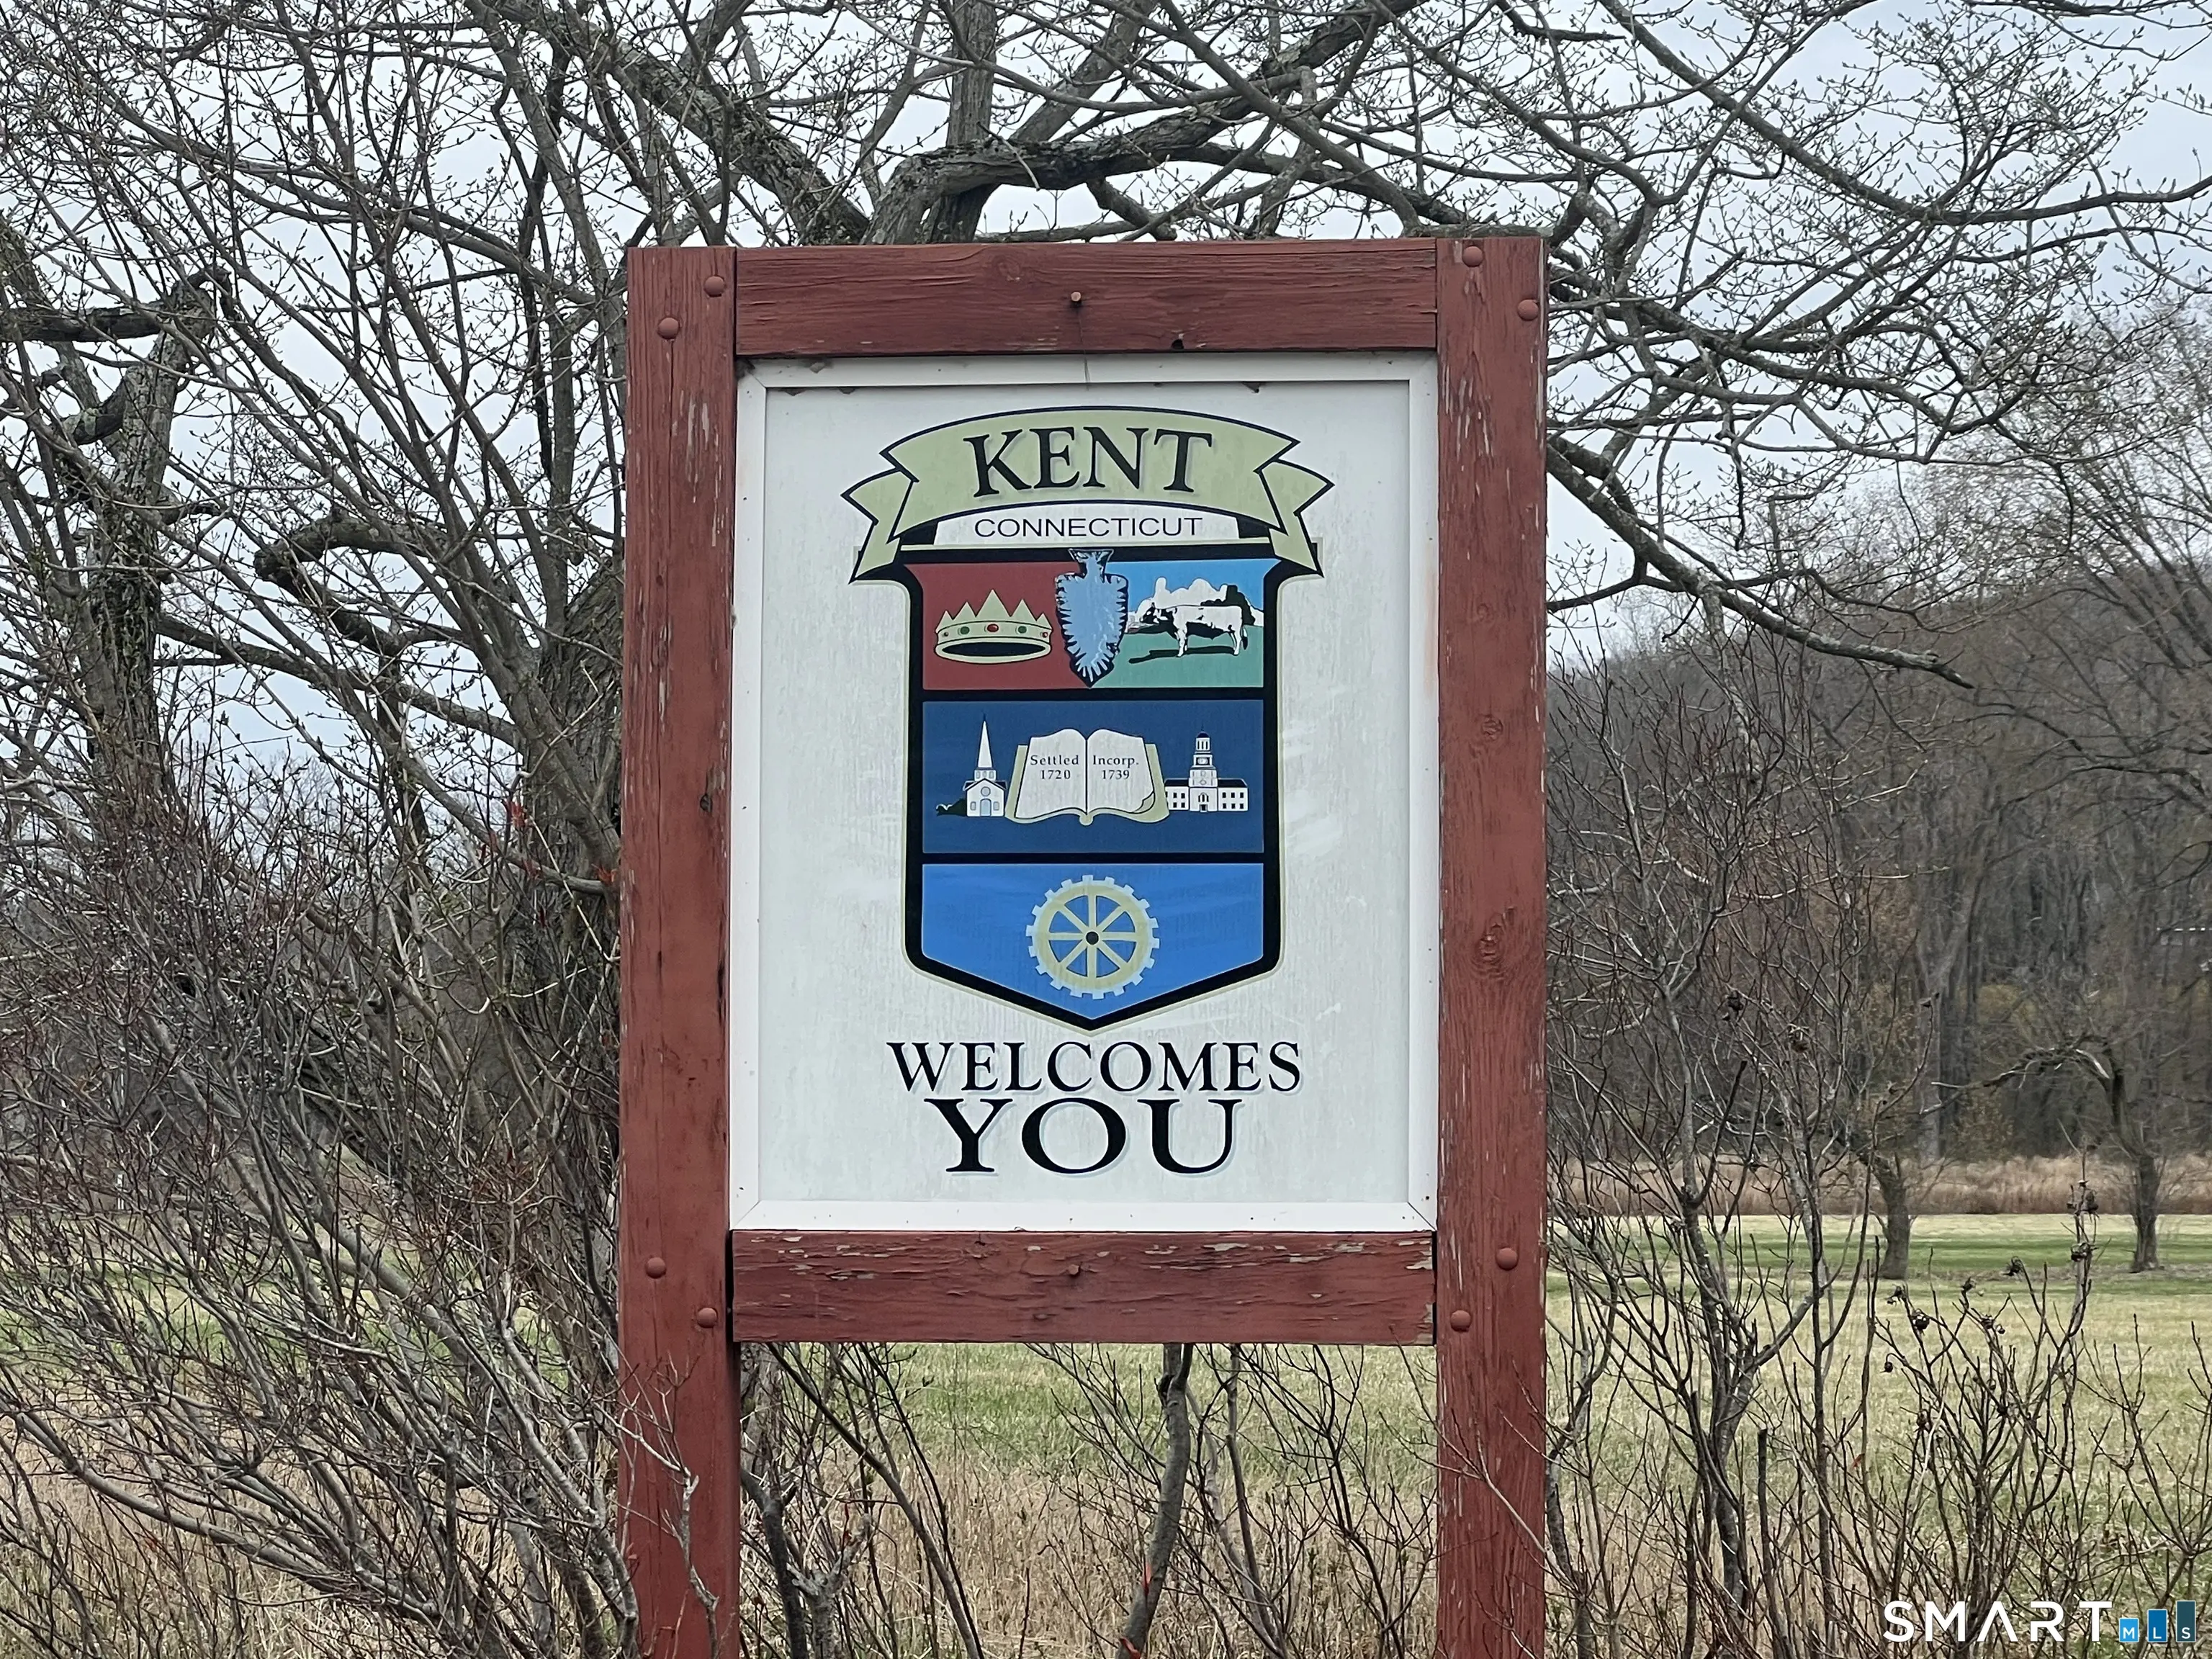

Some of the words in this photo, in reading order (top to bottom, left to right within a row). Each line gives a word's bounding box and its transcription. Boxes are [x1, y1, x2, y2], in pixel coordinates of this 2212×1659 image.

[963, 426, 1213, 498] KENT
[974, 516, 1203, 538] CONNECTICUT
[1030, 754, 1079, 766] Settled
[1092, 754, 1139, 768] Incorp.
[1040, 768, 1071, 780] 1720
[1101, 768, 1130, 781] 1739
[886, 1040, 1300, 1092] WELCOMES
[923, 1097, 1243, 1174] YOU
